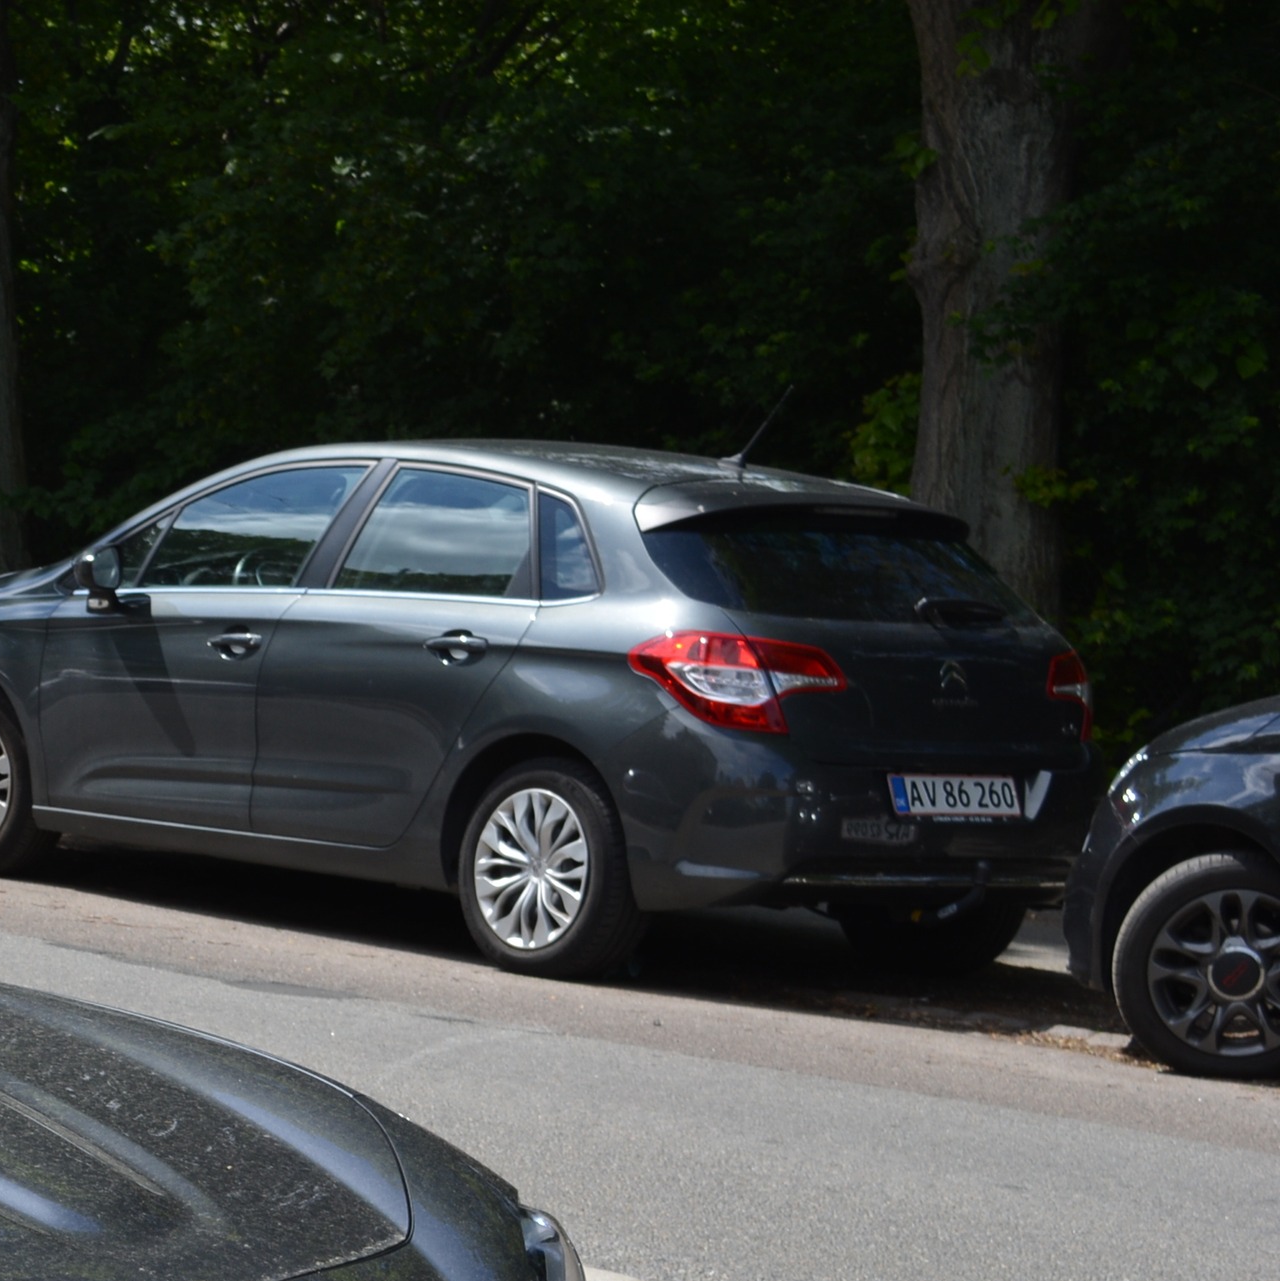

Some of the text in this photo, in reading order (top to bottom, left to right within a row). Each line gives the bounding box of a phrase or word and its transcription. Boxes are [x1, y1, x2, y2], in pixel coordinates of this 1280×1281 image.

[910, 780, 1015, 809] AV 86 260
